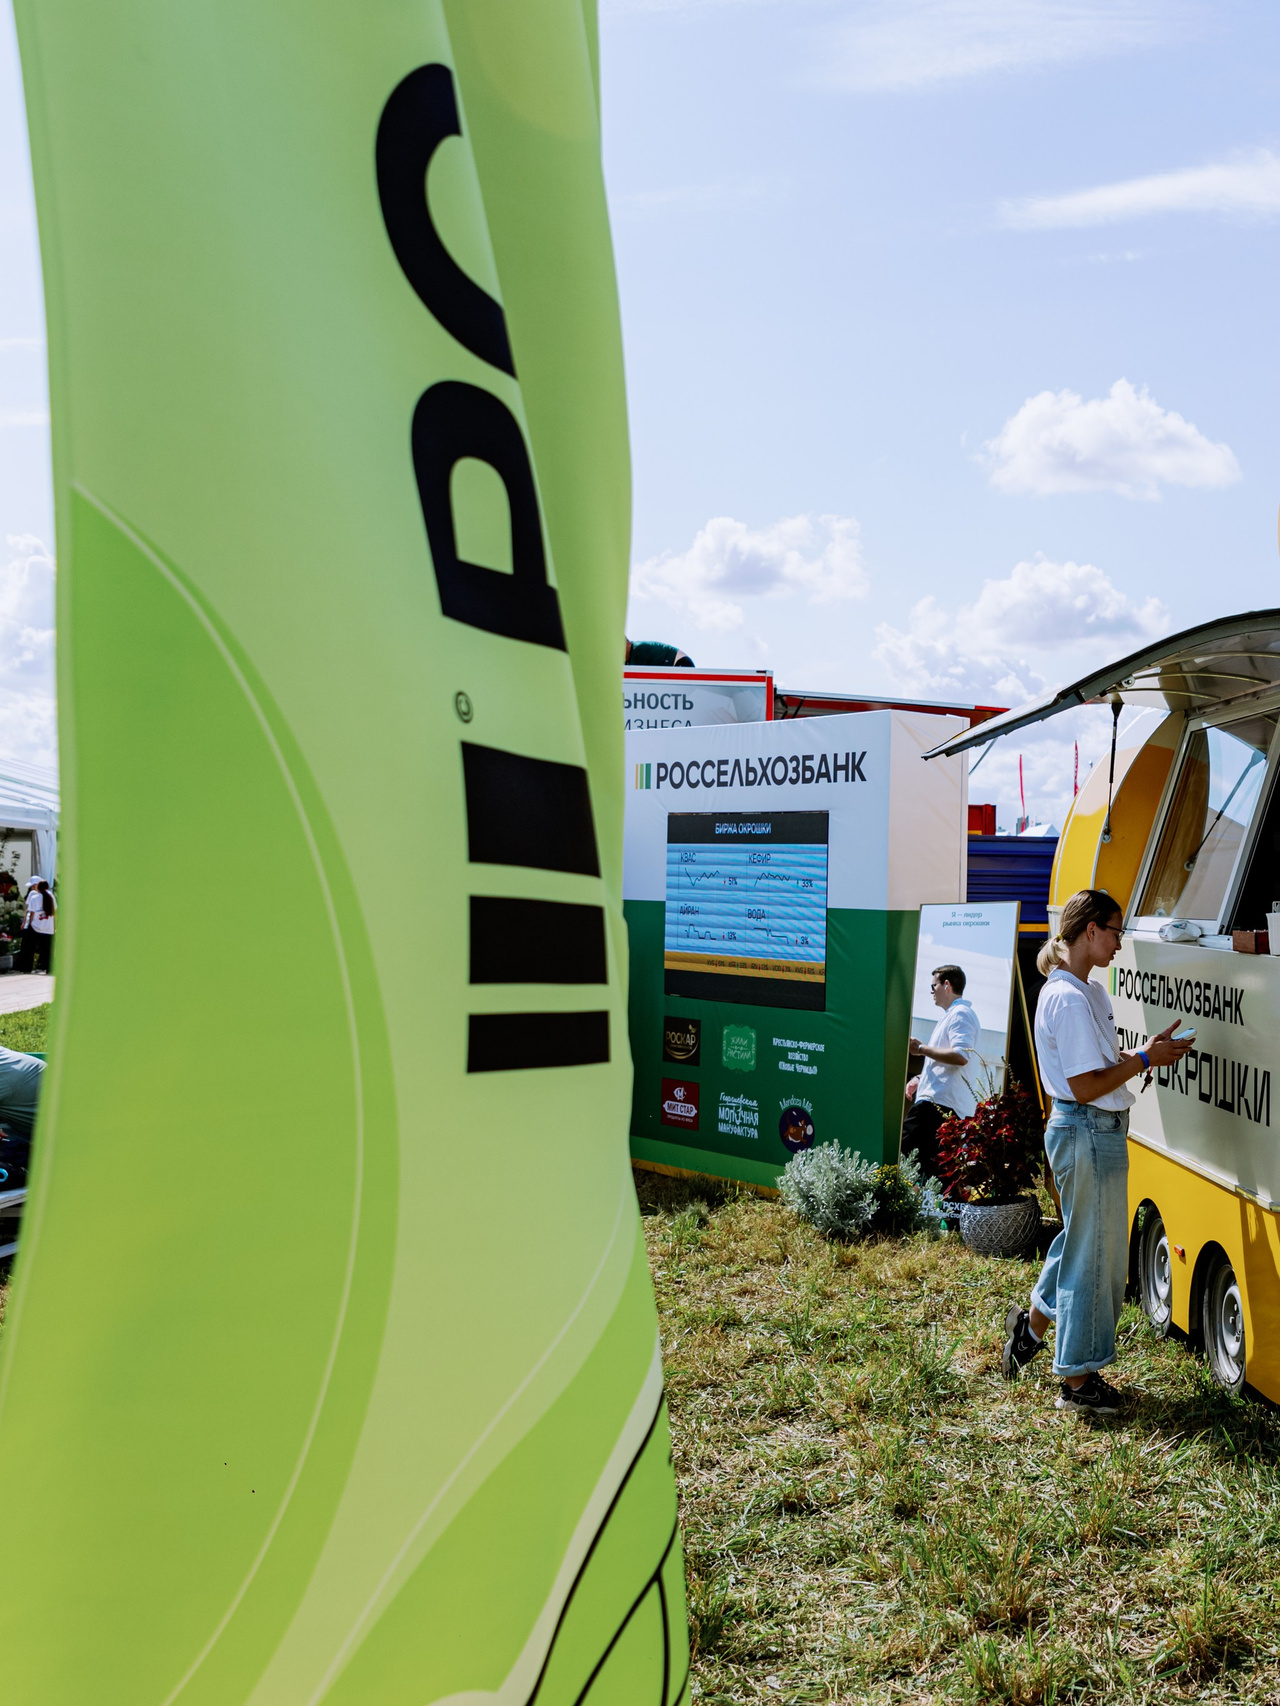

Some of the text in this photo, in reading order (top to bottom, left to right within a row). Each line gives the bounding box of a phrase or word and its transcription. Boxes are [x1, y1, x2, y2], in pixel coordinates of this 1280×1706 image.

[656, 751, 868, 789] РОССЕЛЬХОЗБАНК
[715, 823, 772, 834] БИРЖА ОКРОШКИ
[680, 853, 696, 863] КВАС
[749, 853, 771, 864] КЕФИР
[680, 903, 700, 915] АЙРАН
[748, 908, 766, 920] ВОДА
[1118, 967, 1245, 1026] РОССЕЛЬХОЗБАНК
[666, 1031, 696, 1046] РОСКАР
[667, 1102, 693, 1115] МИТ СТАР
[718, 1122, 758, 1139] МАНУФАКТУРА
